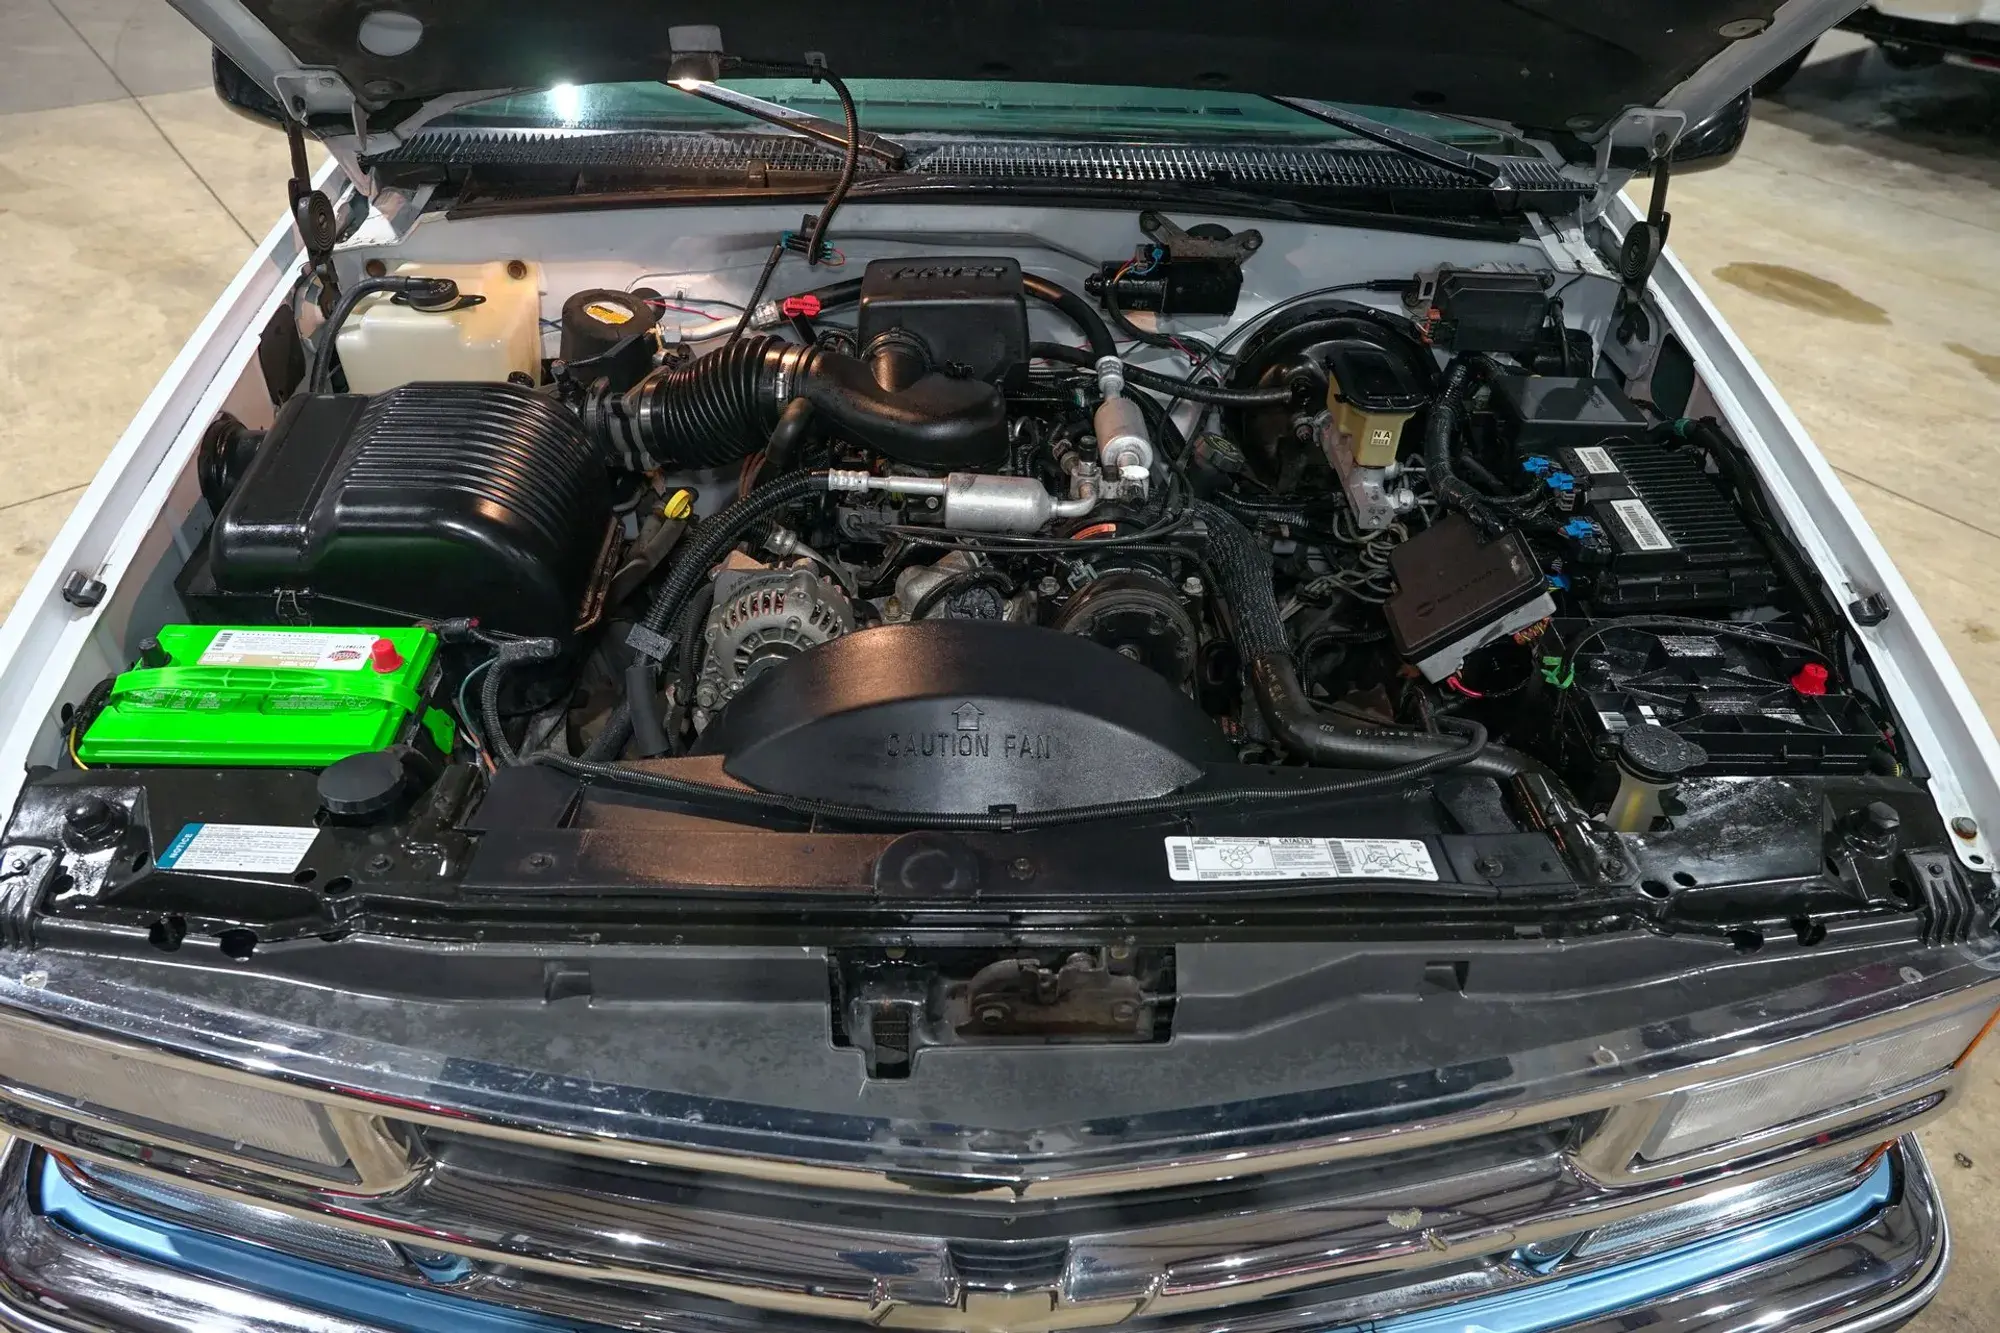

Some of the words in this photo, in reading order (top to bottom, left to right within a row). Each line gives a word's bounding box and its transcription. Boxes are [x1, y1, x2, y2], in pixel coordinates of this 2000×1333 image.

[886, 733, 989, 758] CAUTION
[1004, 734, 1050, 759] FAN
[169, 833, 194, 858] NOTICE
